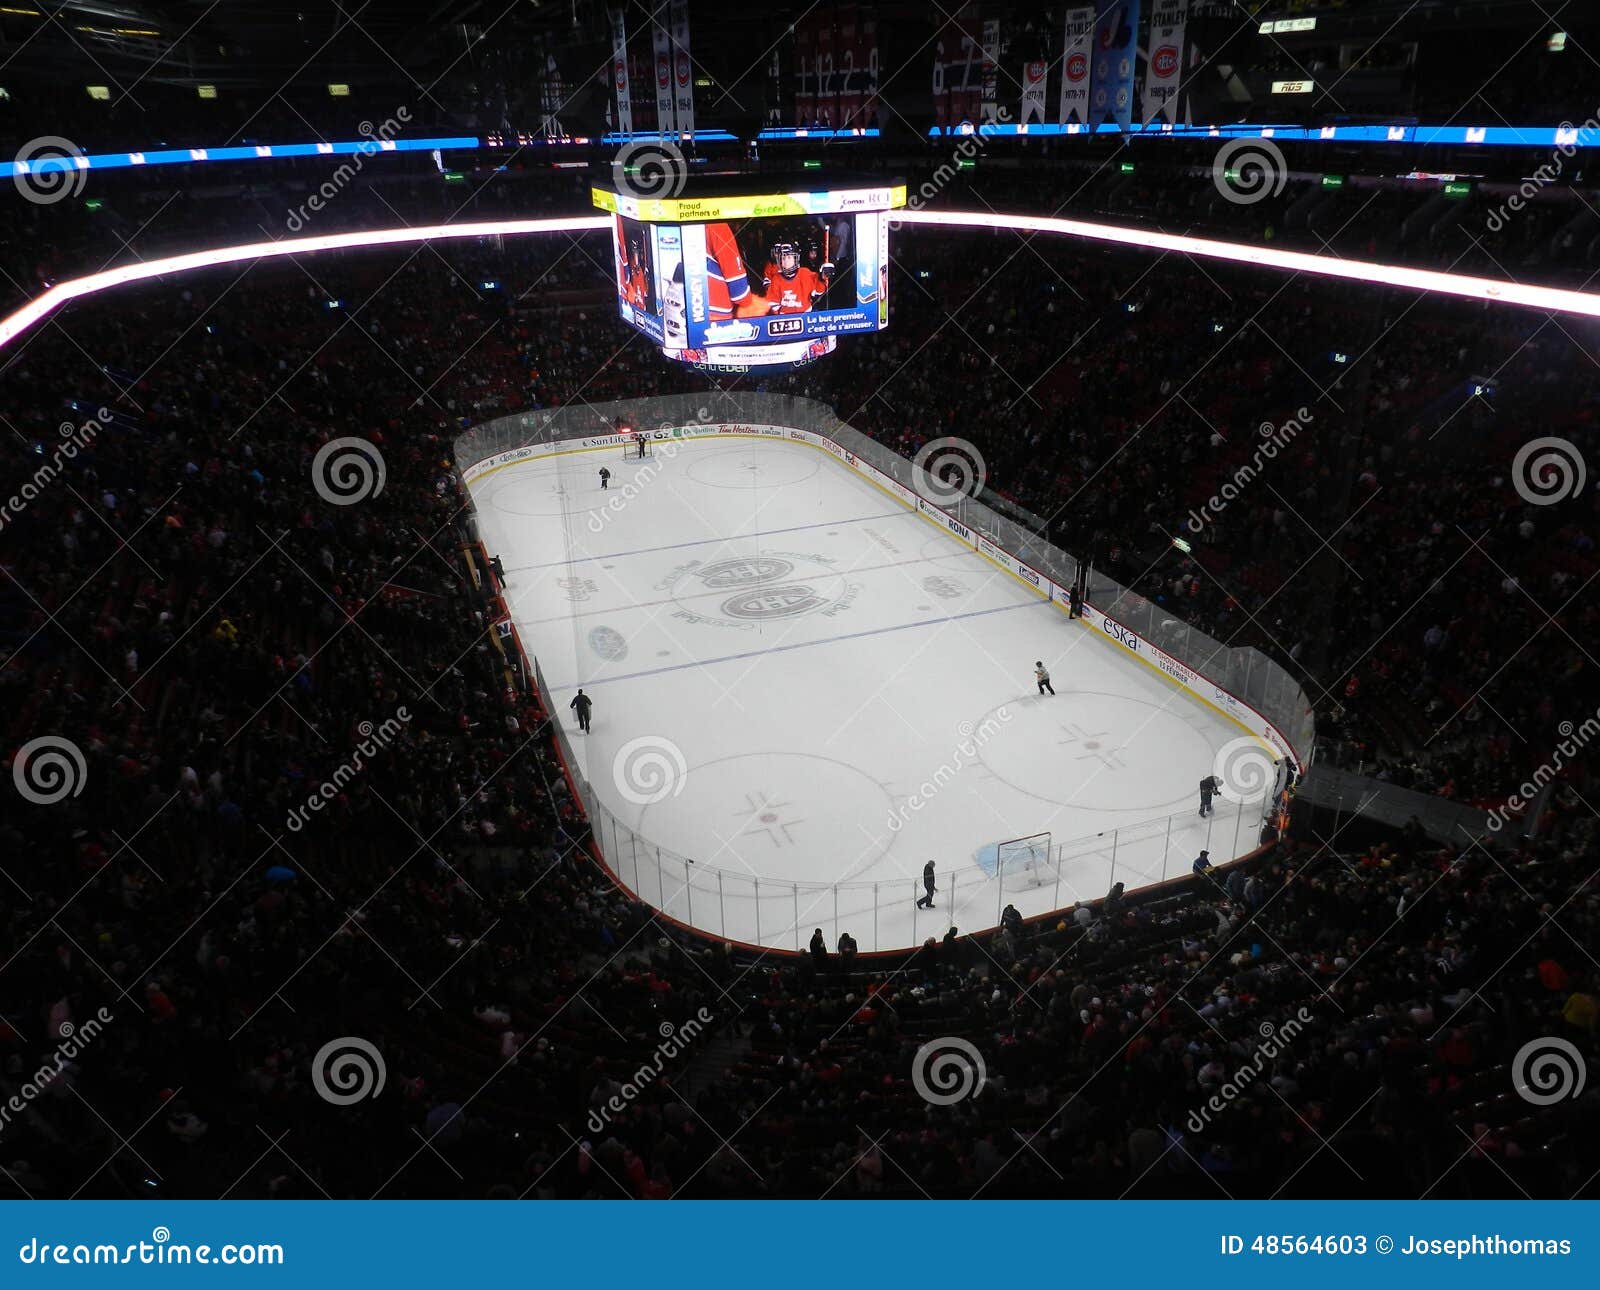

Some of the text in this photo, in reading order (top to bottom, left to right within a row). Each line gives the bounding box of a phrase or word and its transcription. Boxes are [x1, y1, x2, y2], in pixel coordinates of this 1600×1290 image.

[679, 210, 711, 219] partners
[807, 313, 867, 324] Le but premier,
[807, 325, 825, 333] c'est
[838, 322, 874, 331] s'amuser.
[718, 425, 759, 434] Tim Hortons
[591, 435, 626, 447] Sun Life
[822, 438, 842, 457] RICOH
[845, 451, 859, 468] FedEx
[948, 518, 970, 541] RONA
[1103, 617, 1137, 651] eska
[1151, 648, 1158, 656] LE
[1159, 660, 1165, 670] 15
